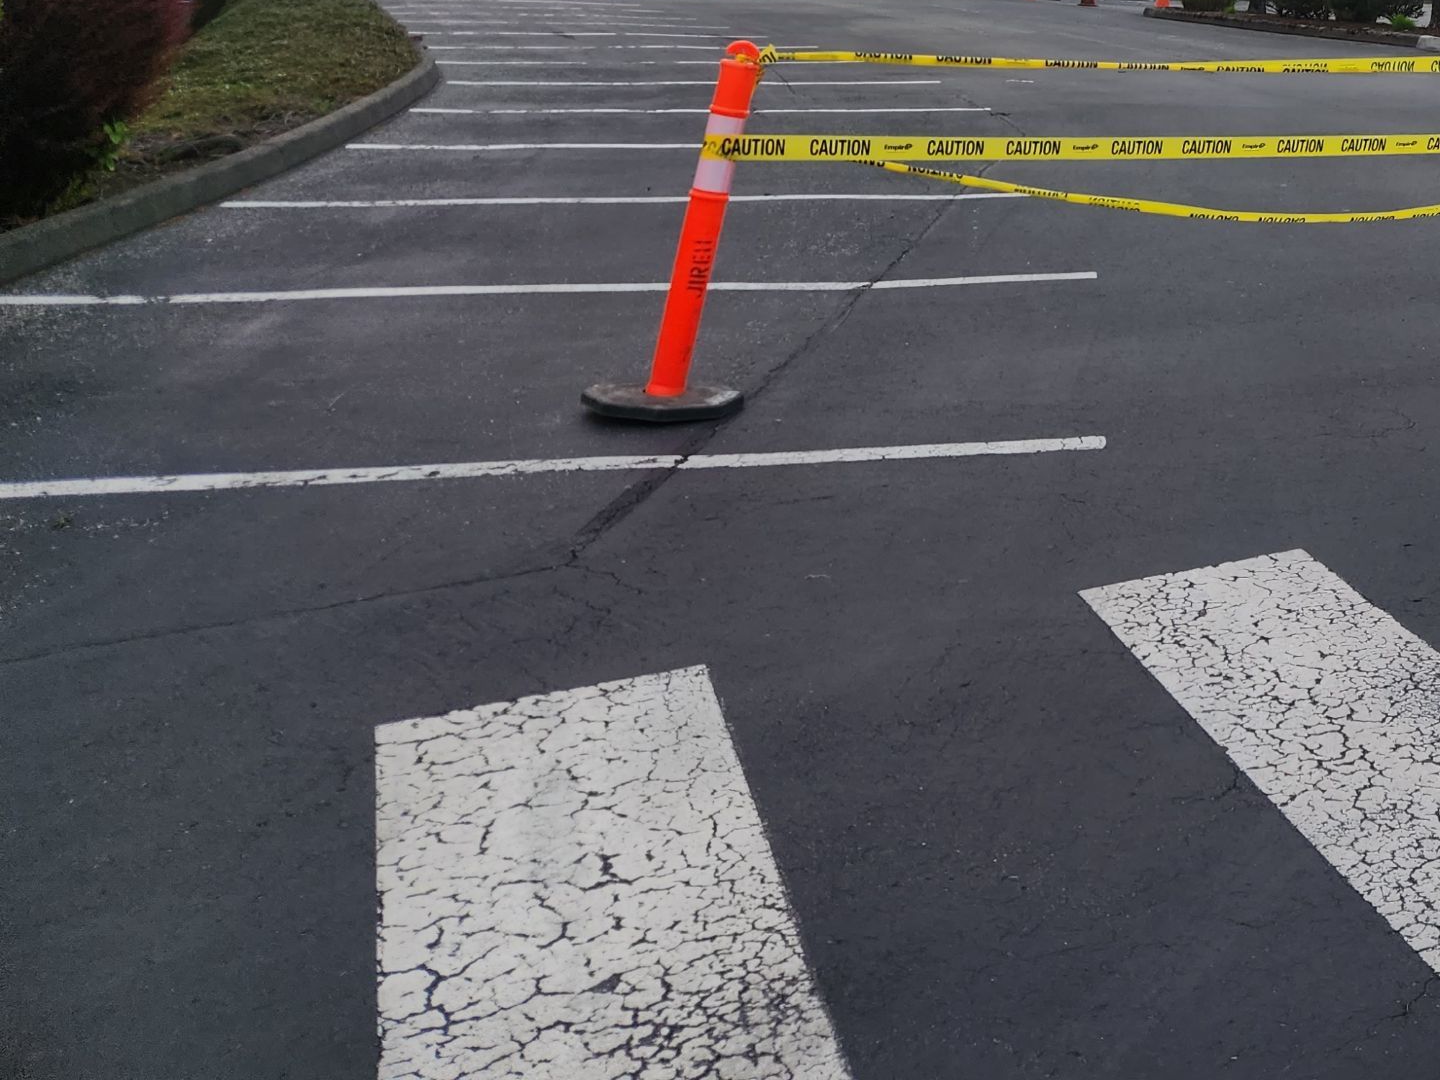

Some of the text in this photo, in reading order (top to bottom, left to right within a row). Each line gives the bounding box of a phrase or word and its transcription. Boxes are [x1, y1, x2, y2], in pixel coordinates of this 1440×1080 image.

[721, 138, 786, 157] CAUTION
[809, 139, 871, 156] CAUTION
[926, 139, 985, 156] CAUTION
[1006, 140, 1061, 156] CAUTION
[1111, 140, 1163, 155] CAUTION
[1181, 139, 1232, 155] CAUTION
[1277, 139, 1324, 153] CAUTION
[1341, 138, 1387, 152] CAUTION
